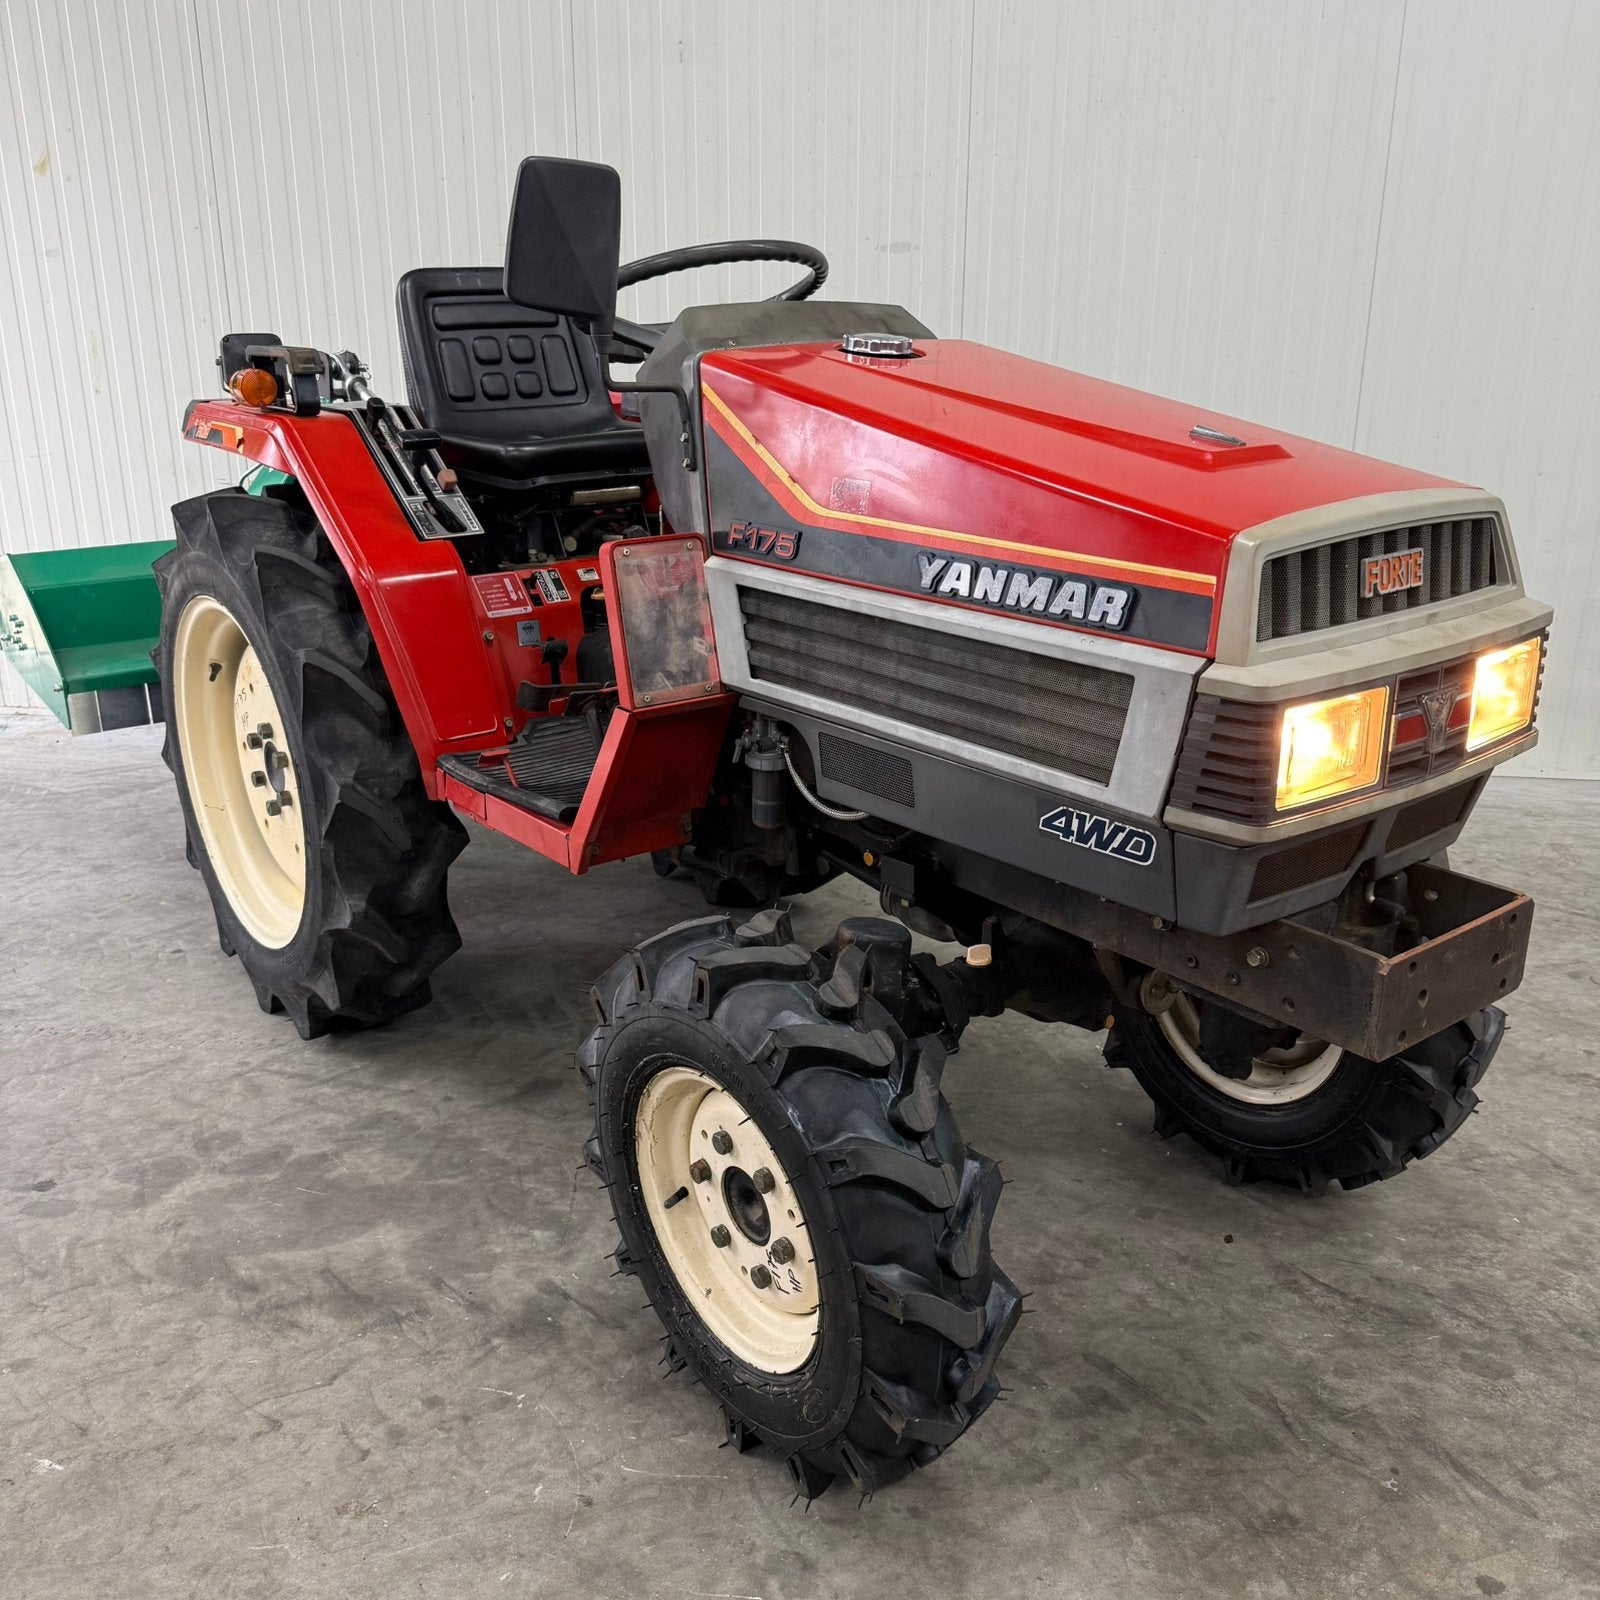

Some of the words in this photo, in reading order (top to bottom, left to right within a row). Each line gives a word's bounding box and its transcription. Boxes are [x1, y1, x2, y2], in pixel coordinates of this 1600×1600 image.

[727, 521, 798, 558] F175
[918, 554, 1131, 628] YANMAR
[1365, 549, 1422, 597] FORTE
[1039, 806, 1157, 866] 4WD
